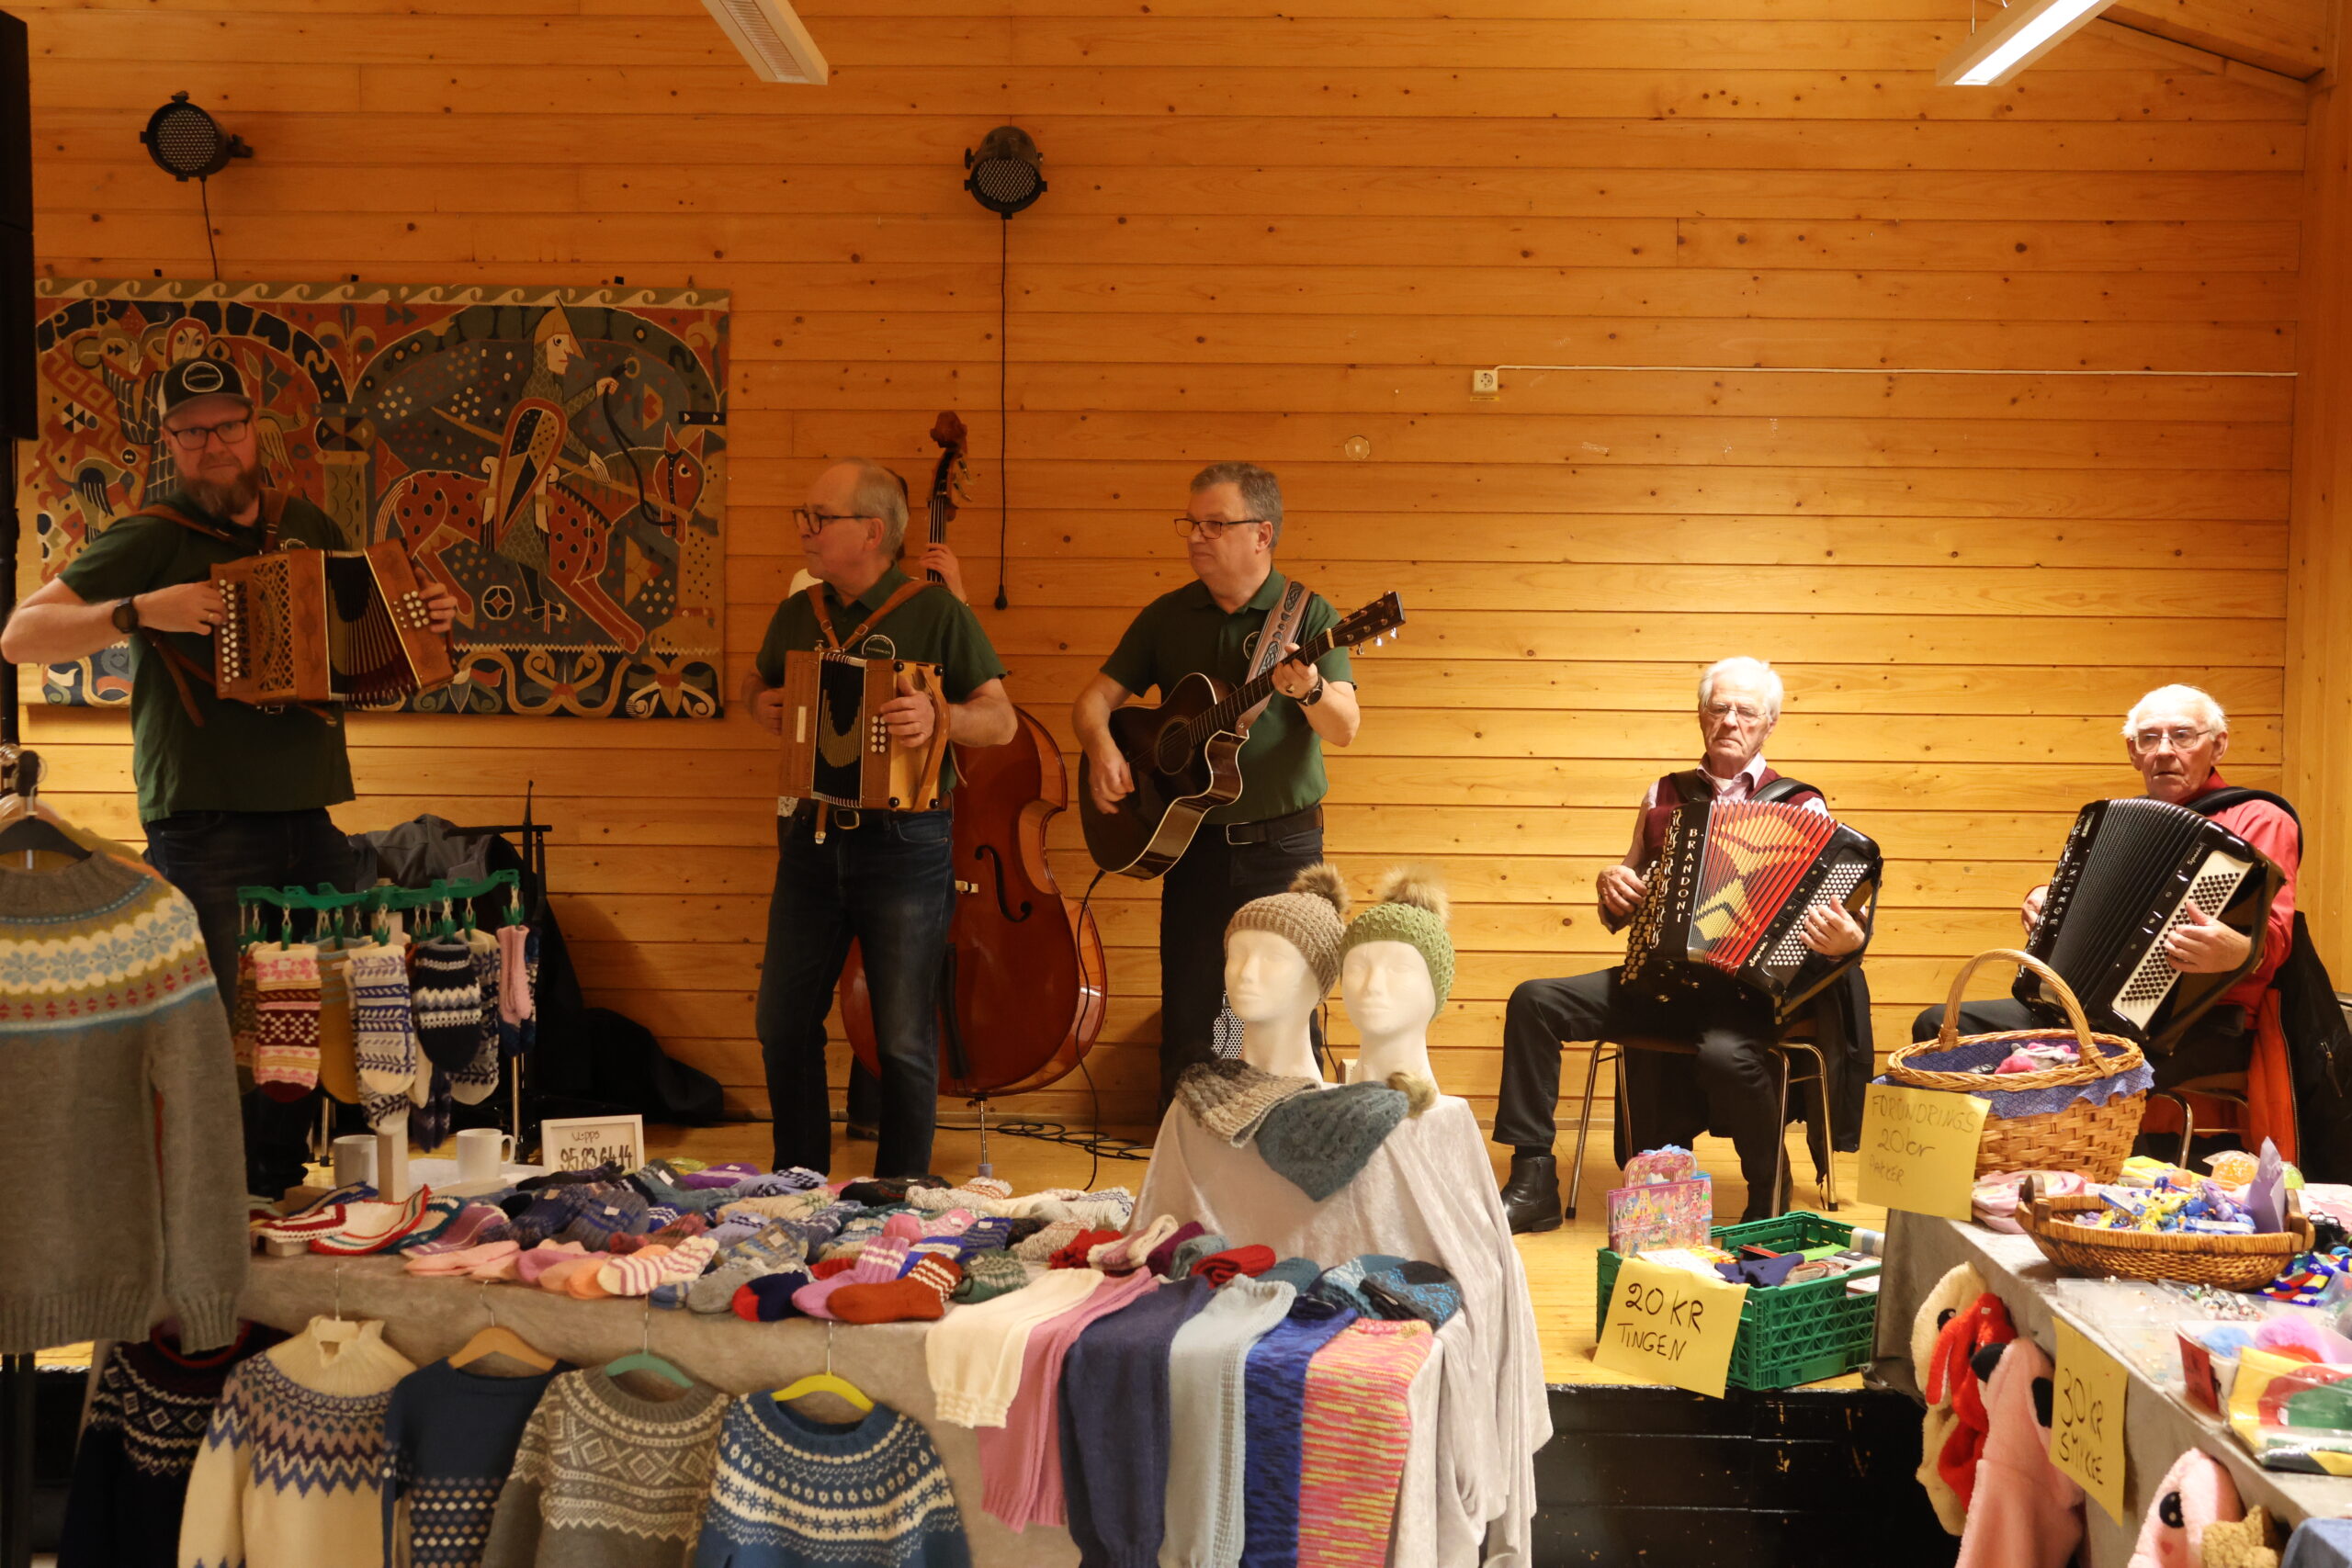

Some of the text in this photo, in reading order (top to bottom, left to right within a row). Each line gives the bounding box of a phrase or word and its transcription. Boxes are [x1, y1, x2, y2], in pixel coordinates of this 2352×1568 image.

[1676, 828, 1698, 923] BRANDONI
[2049, 862, 2081, 926] BORSINI
[1624, 1282, 1704, 1335] 20 KR
[1616, 1322, 1688, 1361] TINGEN
[2060, 1367, 2086, 1427] 30
